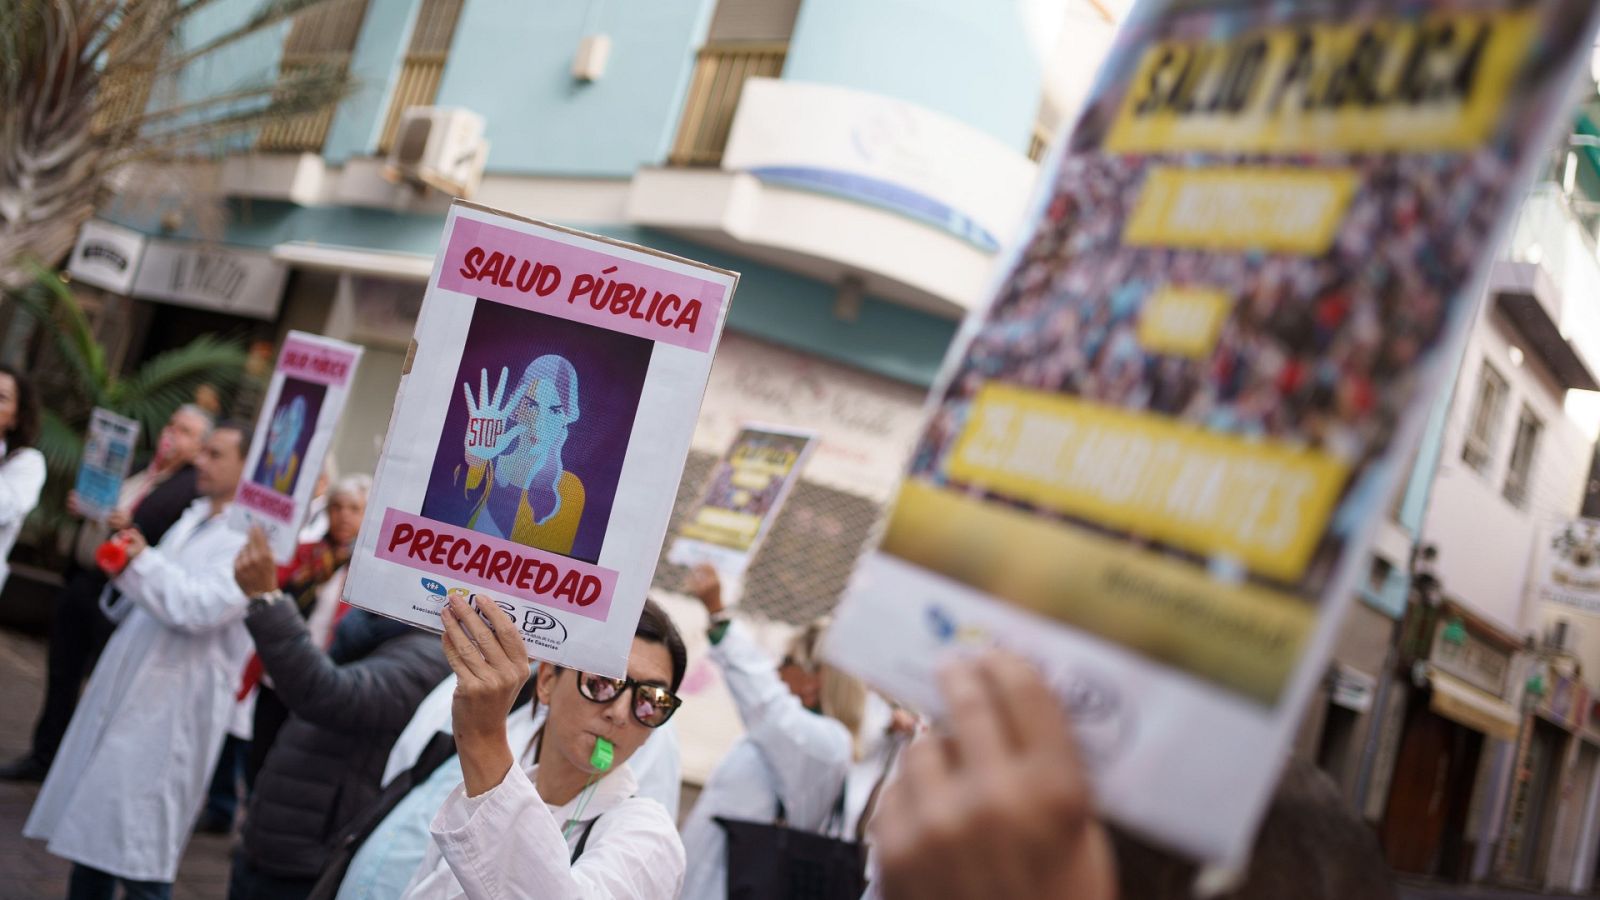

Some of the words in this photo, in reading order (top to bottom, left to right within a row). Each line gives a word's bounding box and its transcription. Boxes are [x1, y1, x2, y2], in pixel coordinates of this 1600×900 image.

[460, 246, 561, 297] SALUD
[567, 266, 702, 333] PÚBLICA
[468, 417, 503, 448] STOP
[388, 523, 602, 607] PRECARIEDAD
